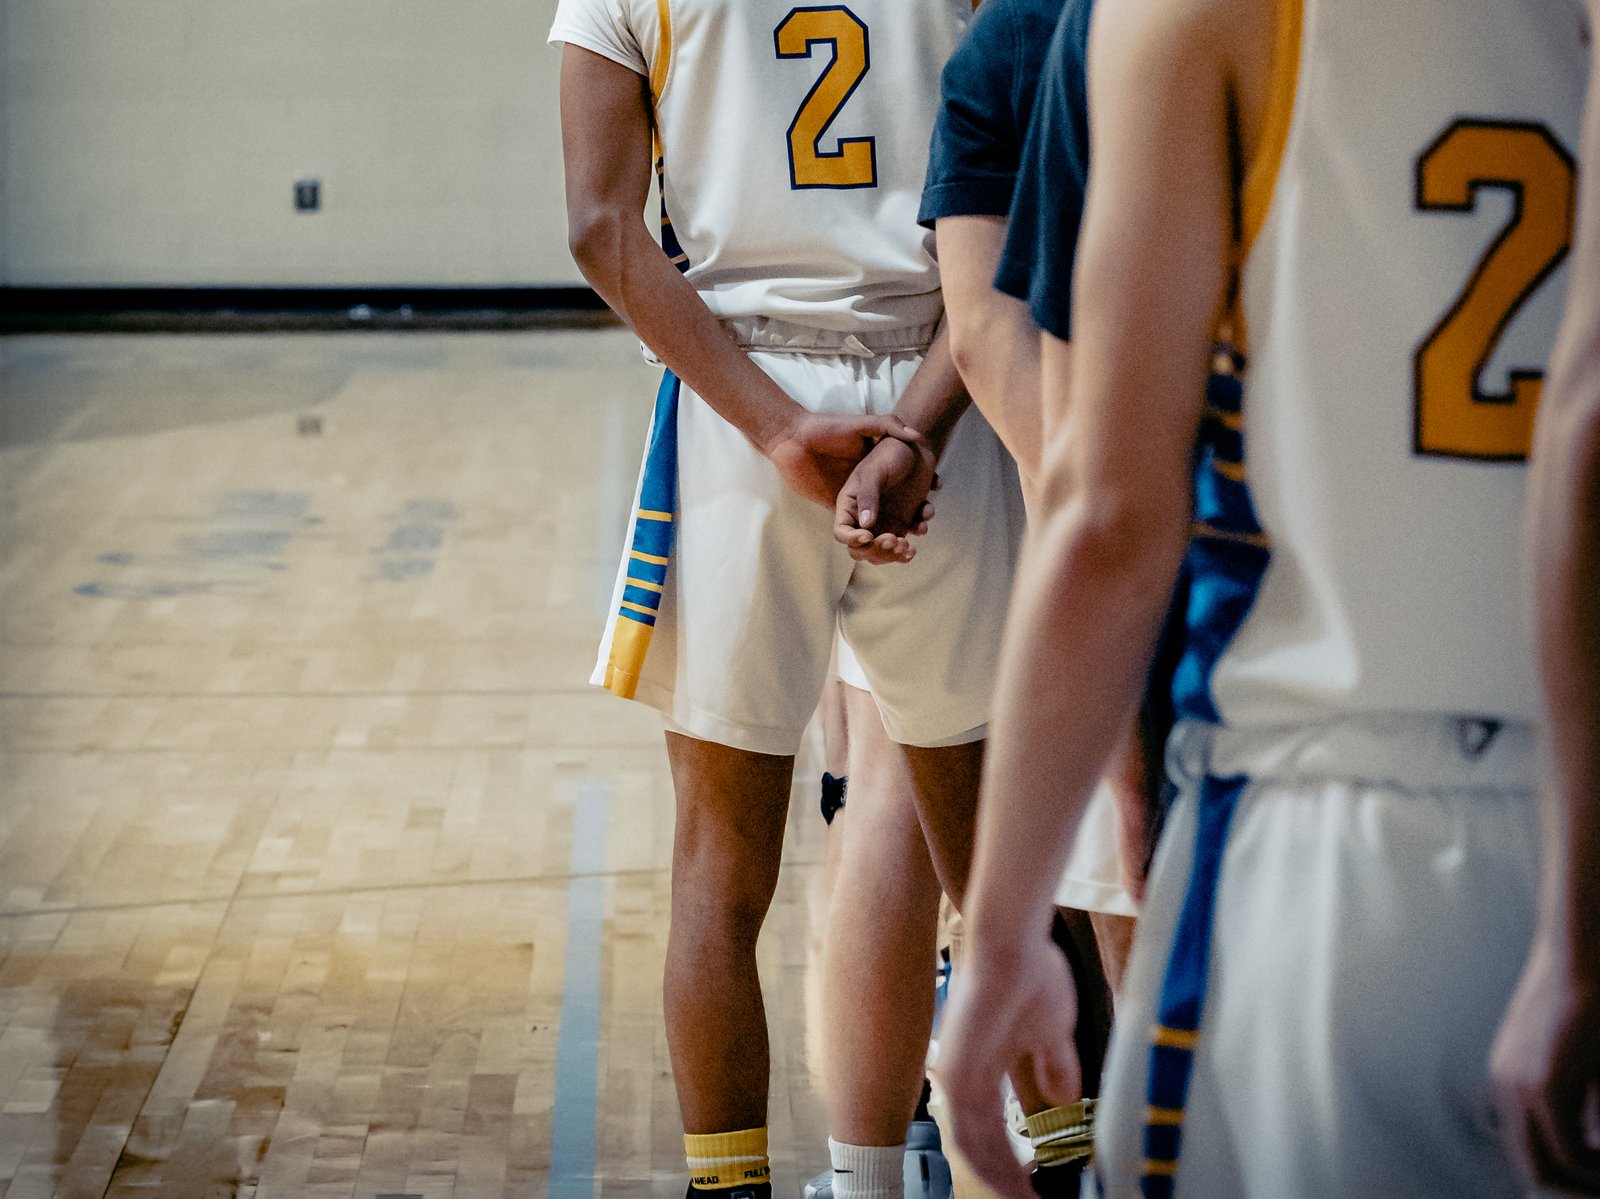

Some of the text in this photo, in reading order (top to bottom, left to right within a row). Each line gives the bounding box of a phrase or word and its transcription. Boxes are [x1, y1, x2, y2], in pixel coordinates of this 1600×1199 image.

[773, 4, 878, 190] 2
[1412, 117, 1578, 462] 2
[694, 1175, 719, 1185] AHEAD
[744, 1168, 763, 1179] FULL
